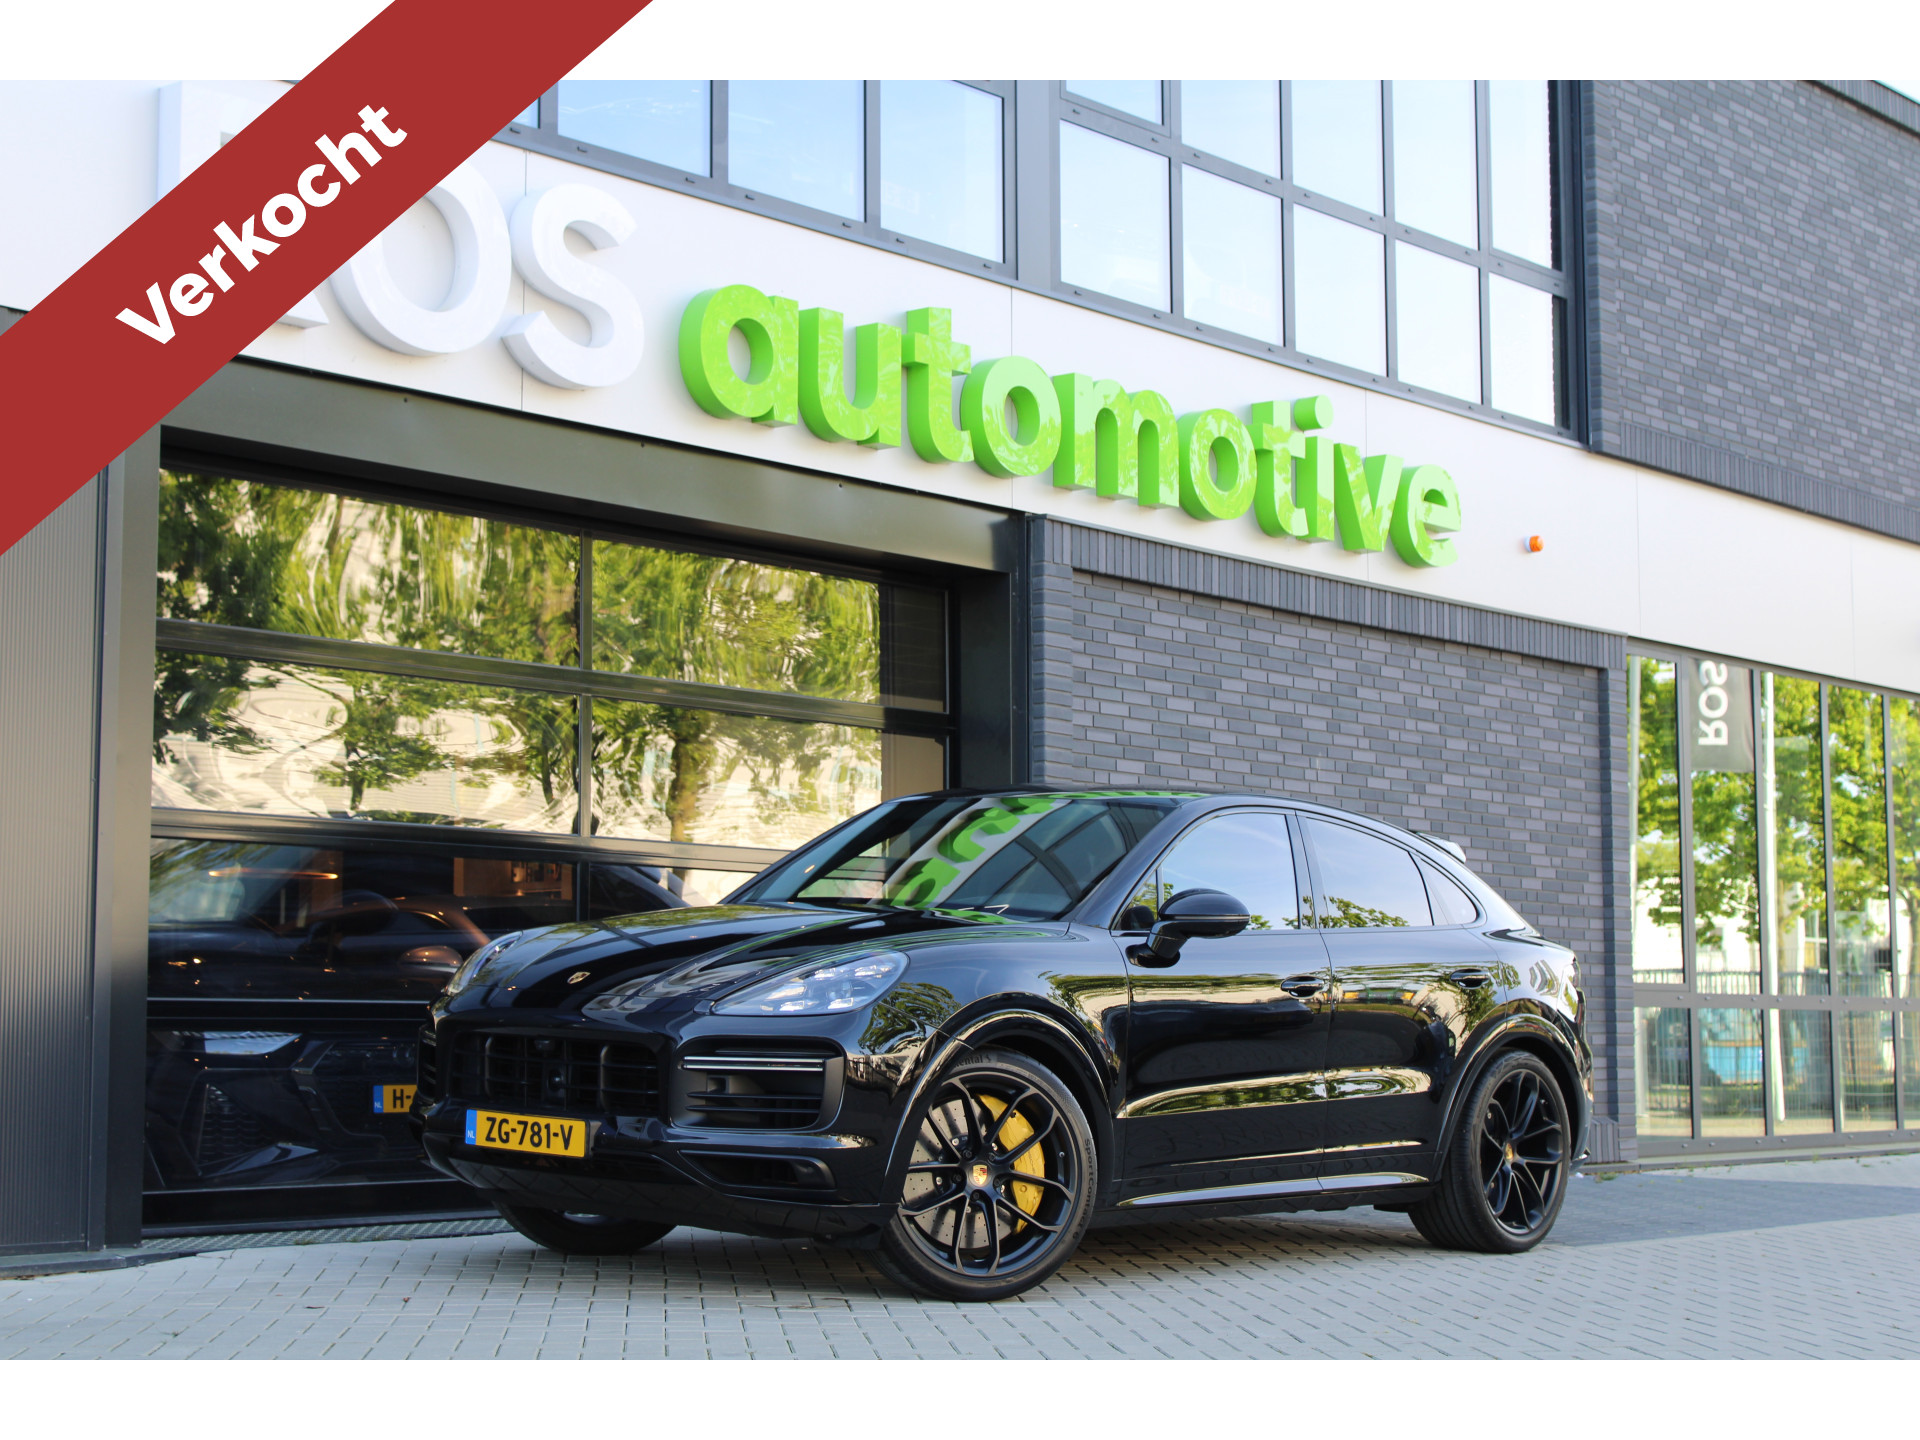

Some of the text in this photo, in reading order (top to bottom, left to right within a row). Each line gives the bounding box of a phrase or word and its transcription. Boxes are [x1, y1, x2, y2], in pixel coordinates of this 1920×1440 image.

[678, 284, 1462, 569] automotive
[467, 1116, 573, 1150] NL ZG-781-V
